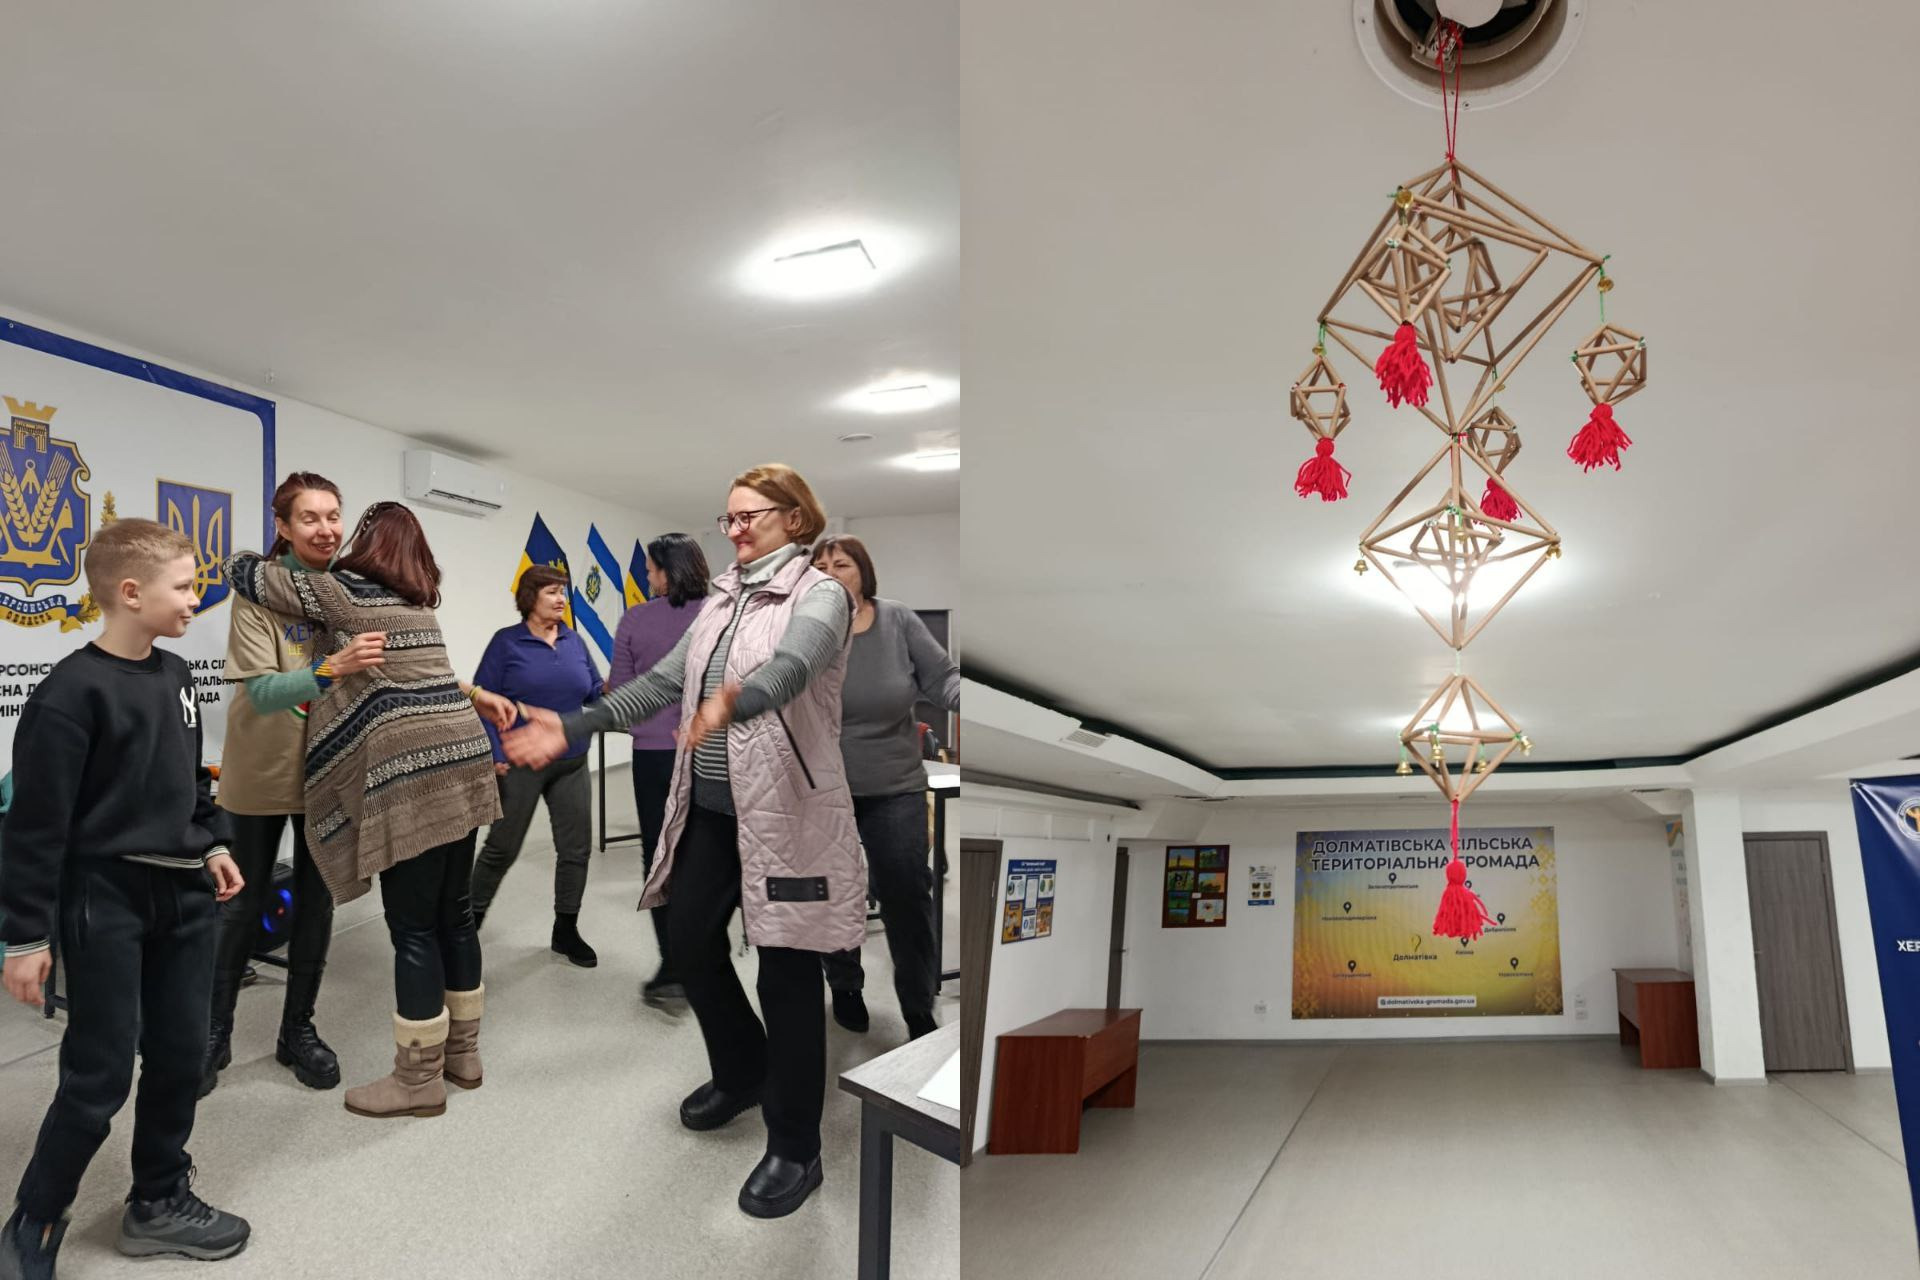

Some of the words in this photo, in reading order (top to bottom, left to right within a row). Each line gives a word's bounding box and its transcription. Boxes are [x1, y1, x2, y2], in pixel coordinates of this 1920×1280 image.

[0, 596, 63, 612] ЕРСОНСЬКА
[187, 659, 209, 670] ЬКА
[197, 691, 220, 704] АДА
[1313, 839, 1445, 855] ДОЛМАТІВСЬКА
[1312, 856, 1450, 870] ТЕРИТОРІАЛЬНА
[1393, 953, 1438, 962] Долматівка
